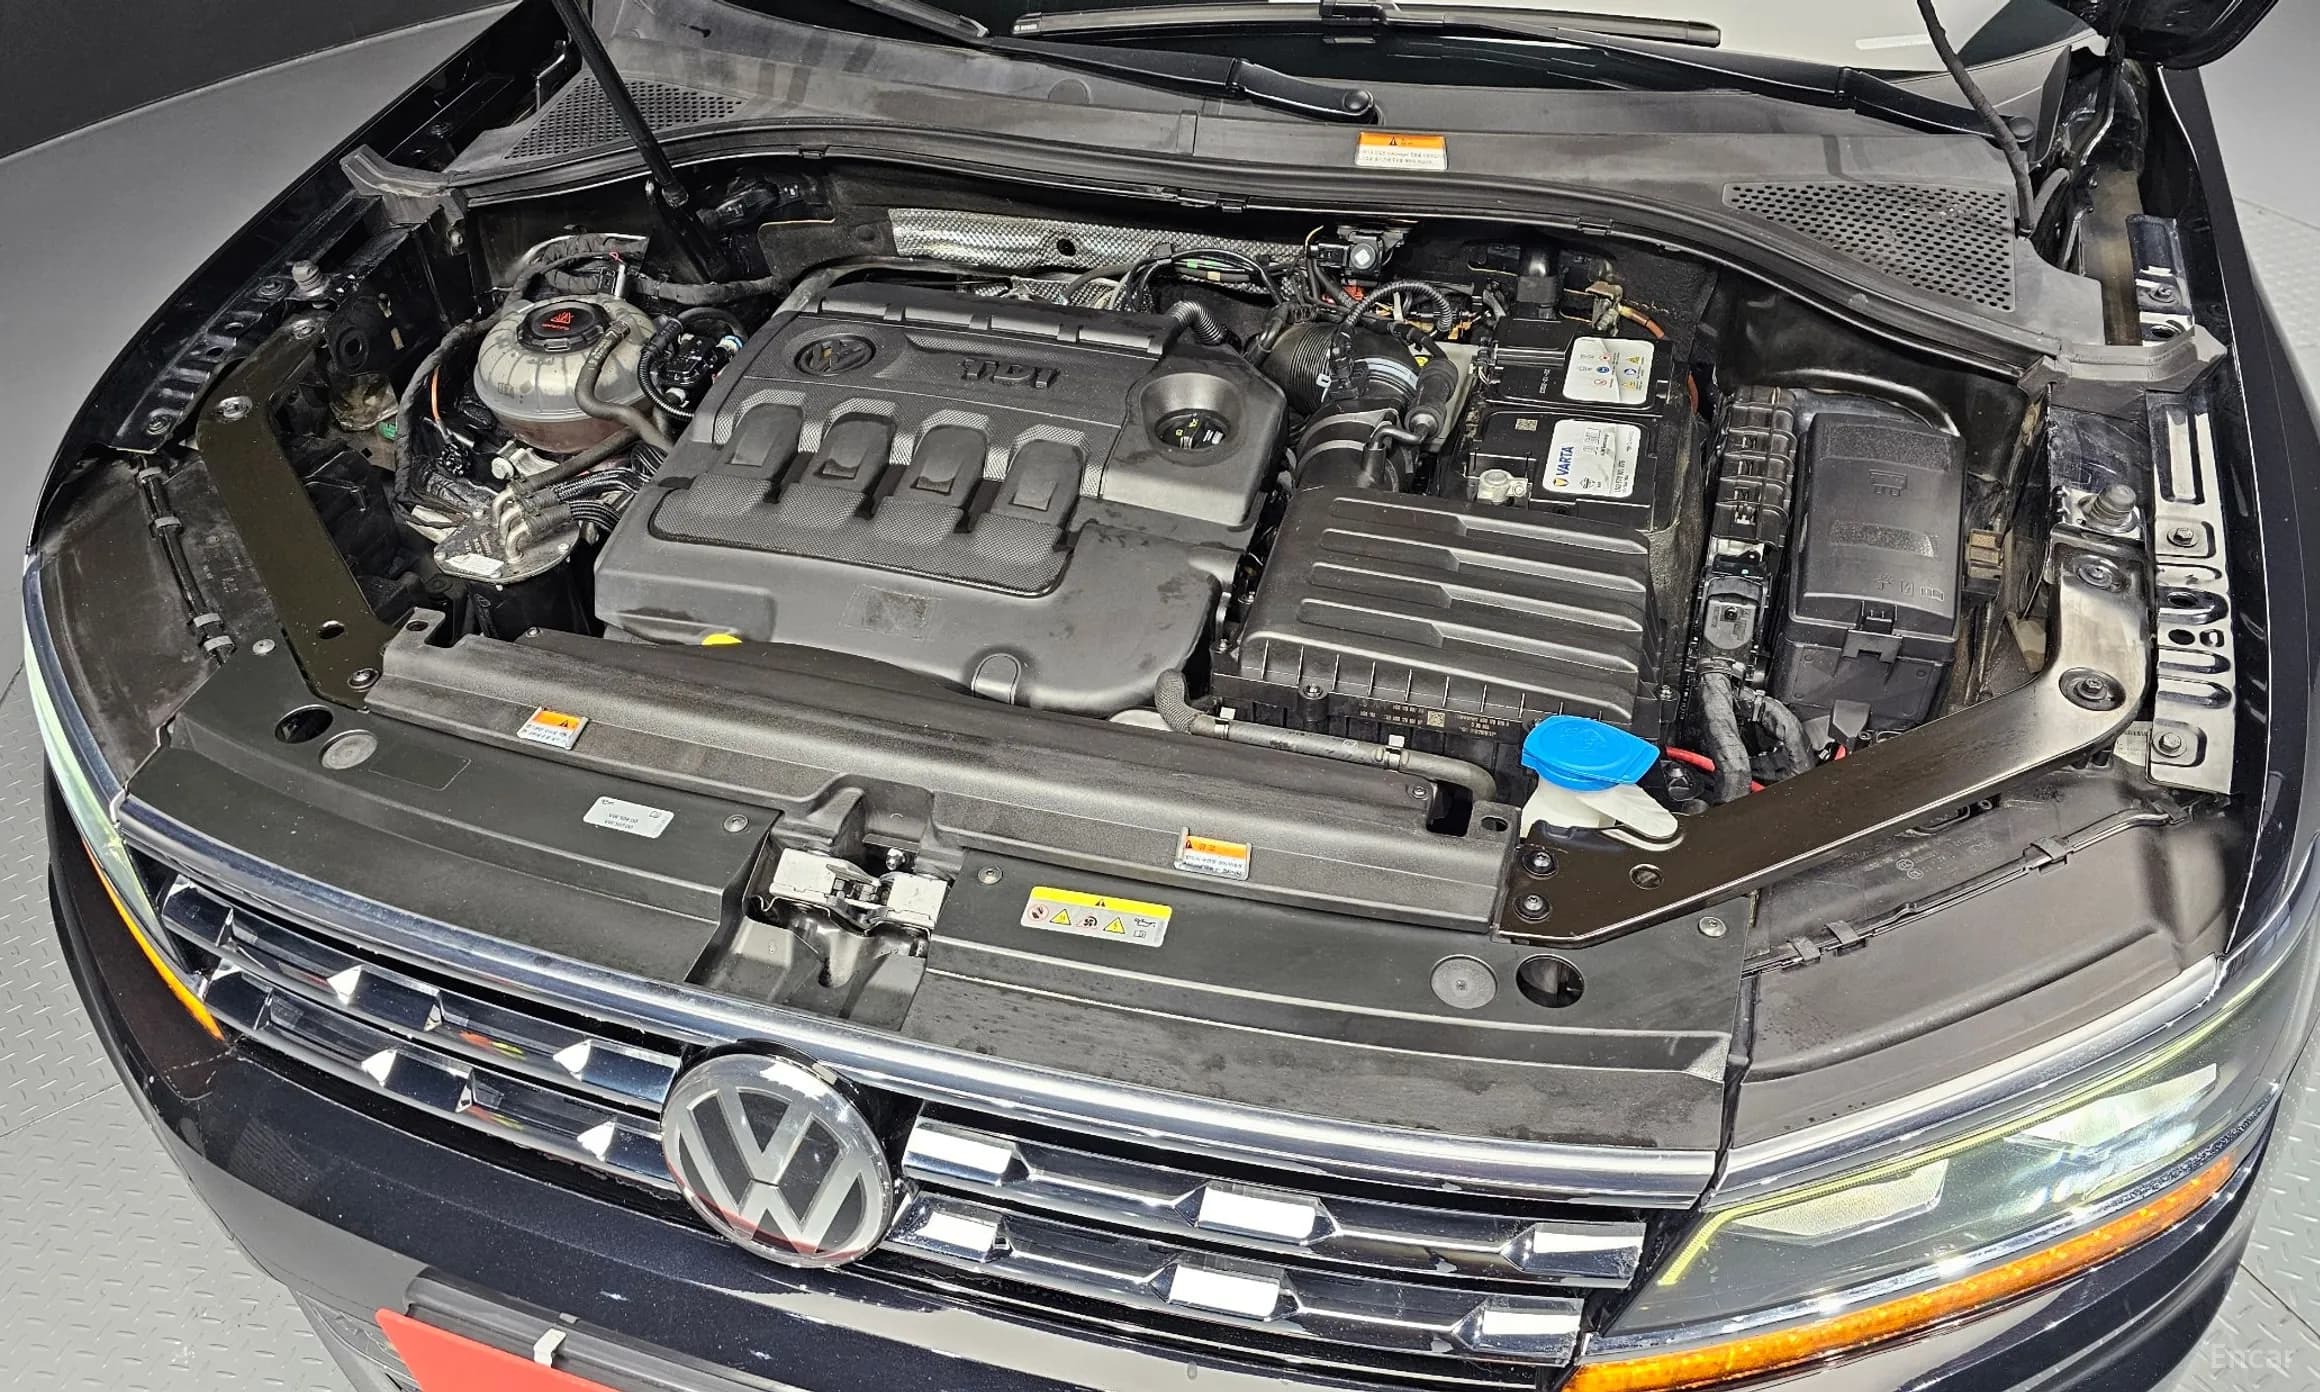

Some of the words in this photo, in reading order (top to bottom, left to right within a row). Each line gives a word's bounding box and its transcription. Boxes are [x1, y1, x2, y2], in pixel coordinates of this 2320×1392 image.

[961, 358, 1061, 389] TDI
[1555, 446, 1575, 476] VARTA
[670, 1076, 874, 1259] VW
